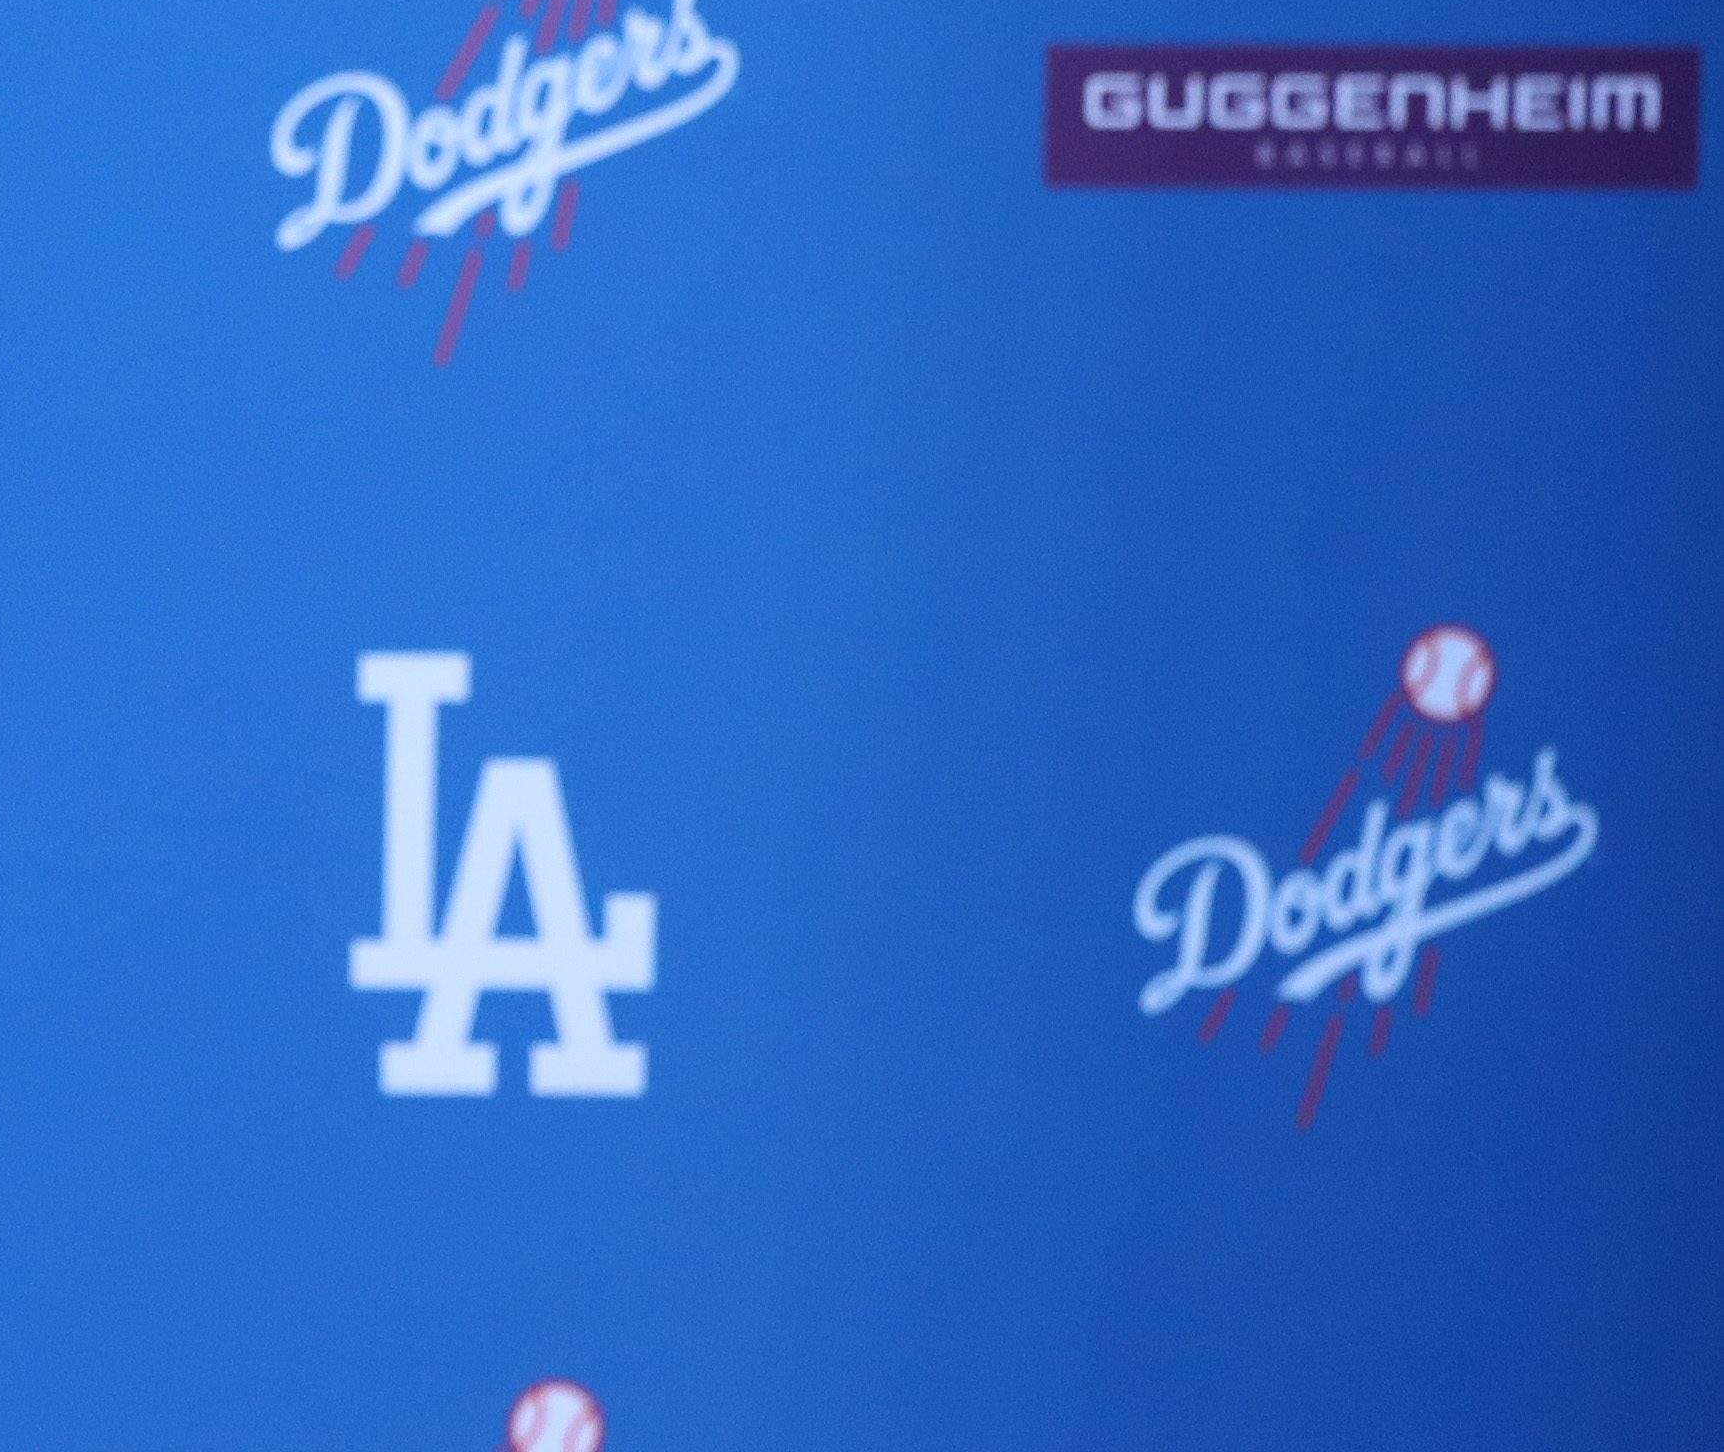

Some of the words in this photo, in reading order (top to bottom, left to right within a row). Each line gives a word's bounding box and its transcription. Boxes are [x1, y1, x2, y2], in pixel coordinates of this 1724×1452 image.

[1082, 72, 1662, 131] GUGGENHEIM
[348, 650, 657, 1097] LA
[1134, 753, 1596, 1012] Dodgers
